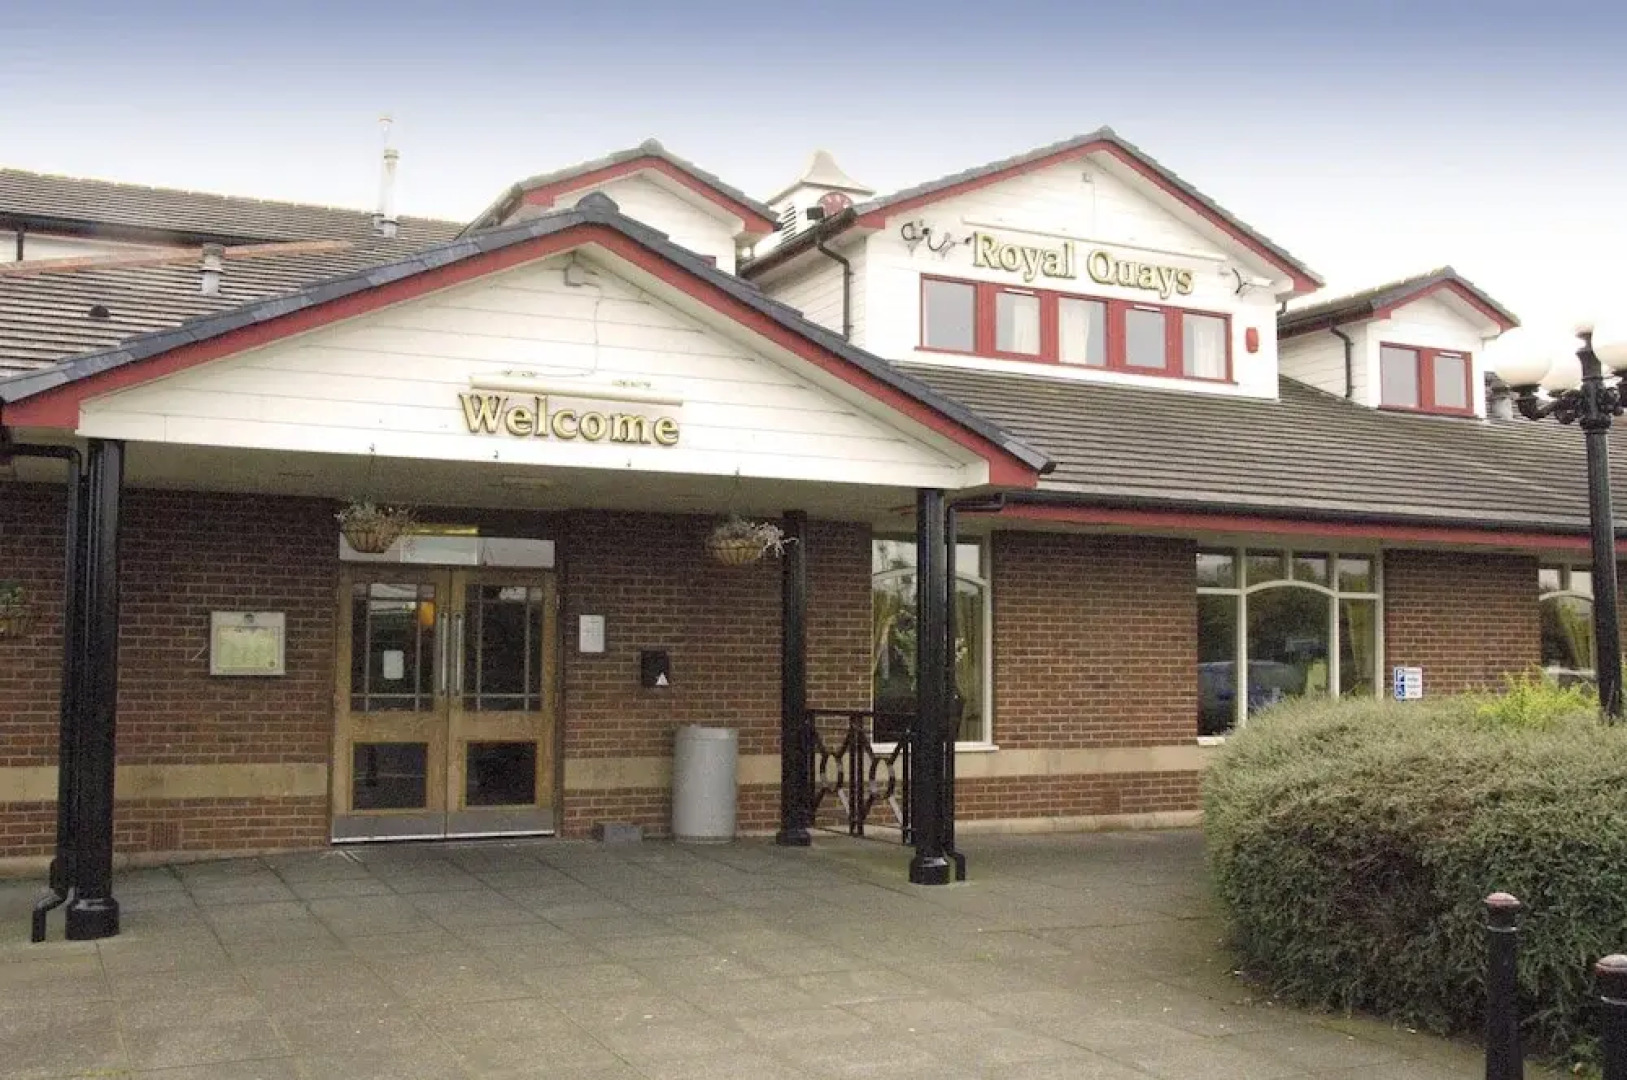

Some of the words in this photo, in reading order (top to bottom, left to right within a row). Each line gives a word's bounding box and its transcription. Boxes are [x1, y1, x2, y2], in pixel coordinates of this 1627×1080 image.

[973, 231, 1076, 283] Royal
[1087, 249, 1194, 300] Quays
[458, 393, 680, 446] Welcome
